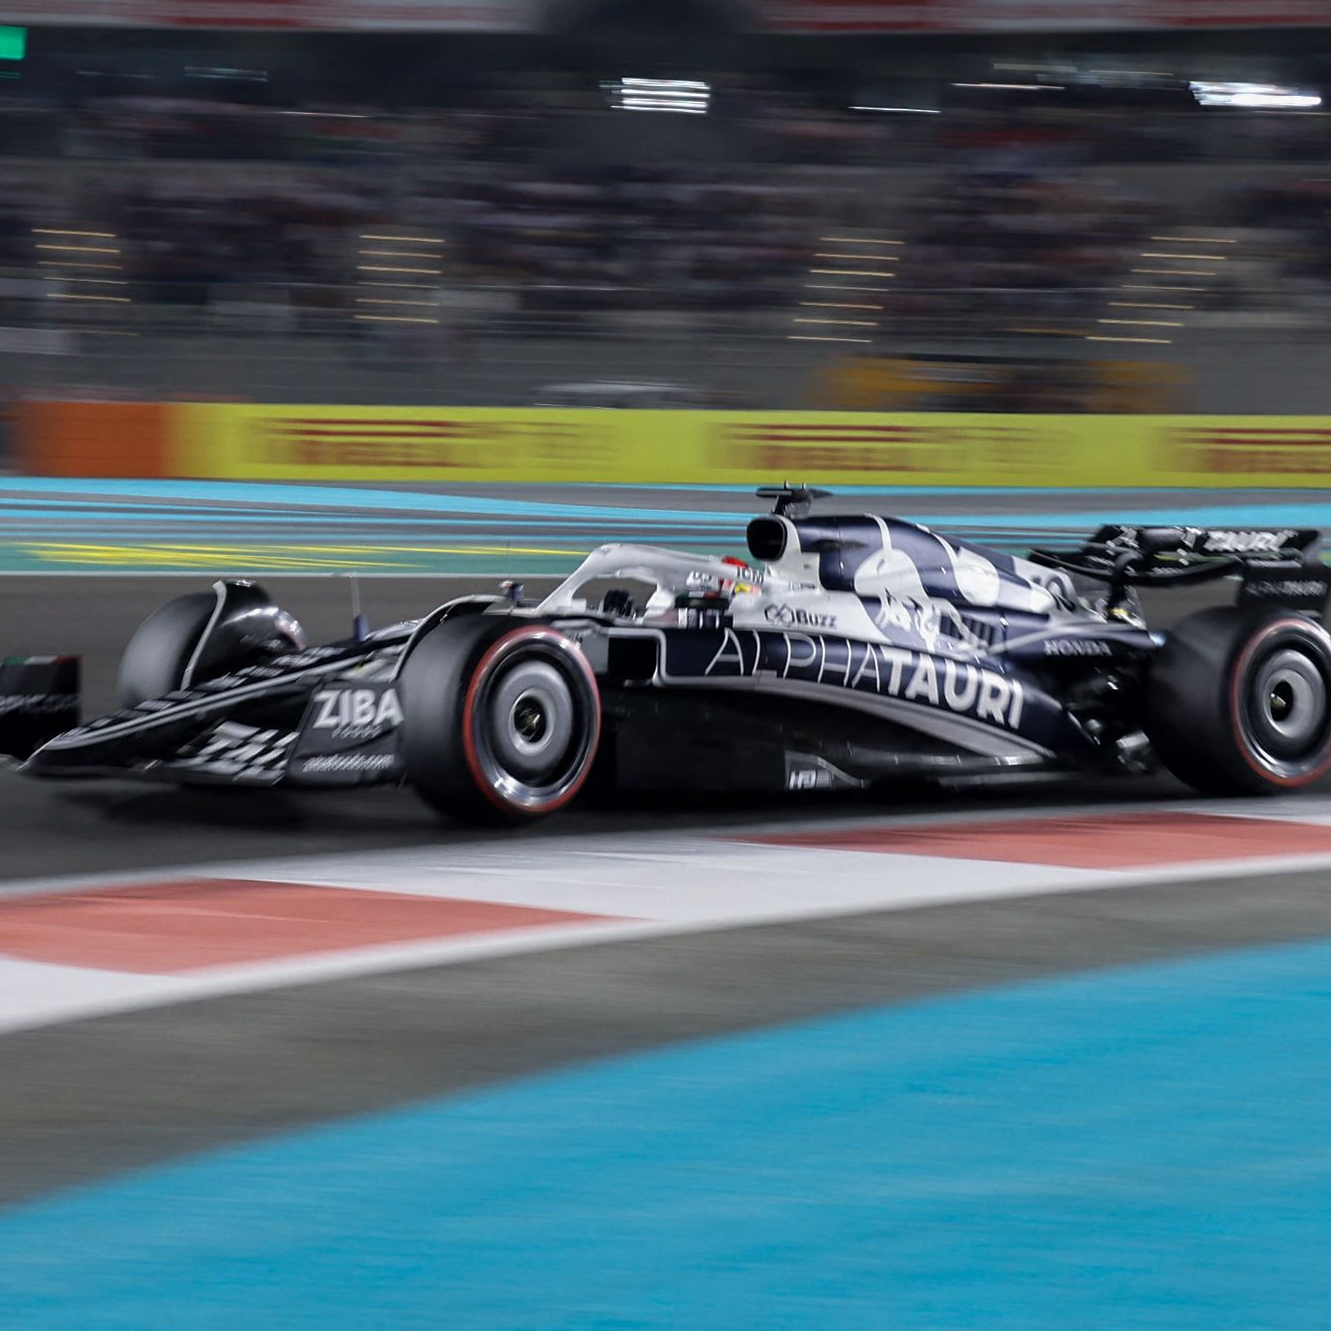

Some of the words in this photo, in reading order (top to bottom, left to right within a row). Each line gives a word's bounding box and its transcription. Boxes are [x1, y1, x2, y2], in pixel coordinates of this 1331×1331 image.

[1044, 639, 1112, 656] HONDA
[704, 628, 1024, 729] ALPHATAURI
[313, 688, 404, 728] ZIBA
